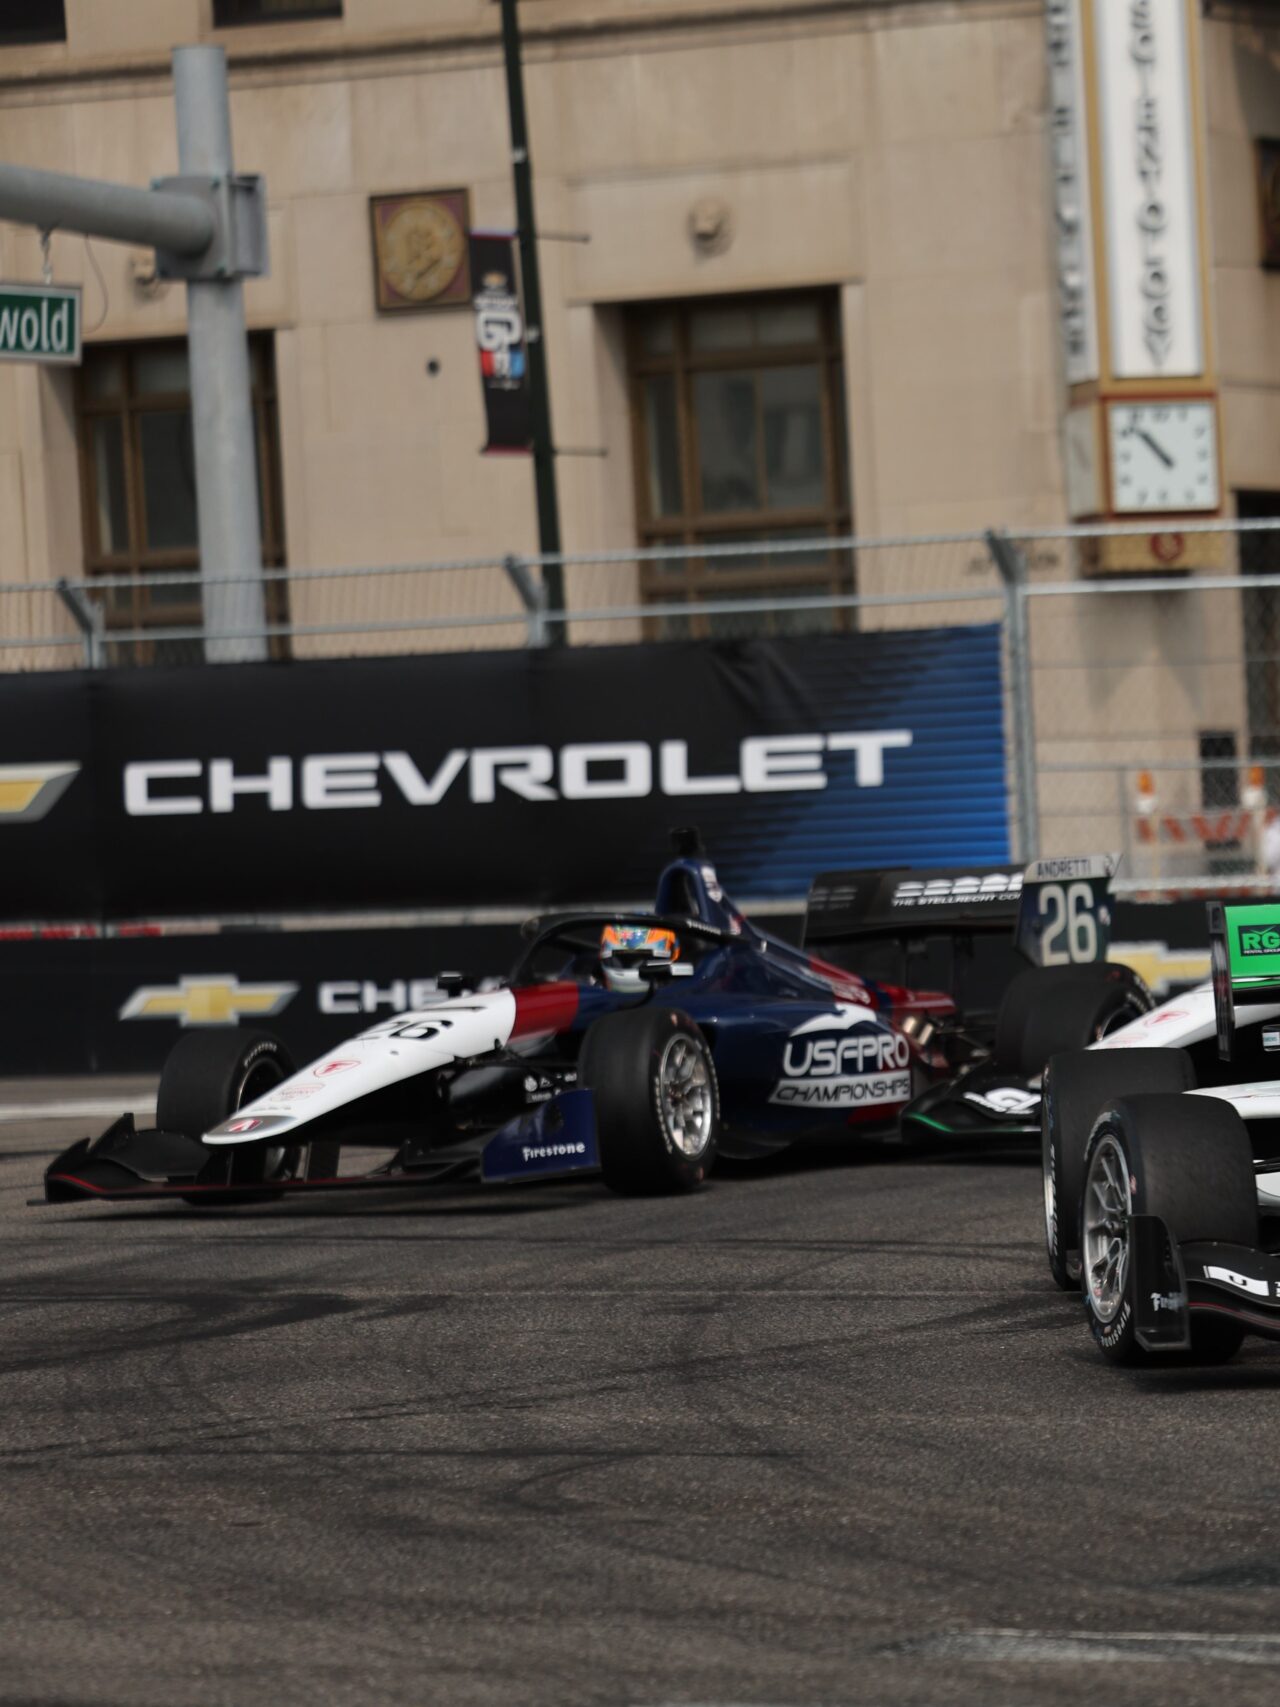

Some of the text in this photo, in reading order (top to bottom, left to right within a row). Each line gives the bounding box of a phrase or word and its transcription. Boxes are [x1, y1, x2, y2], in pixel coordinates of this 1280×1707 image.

[124, 729, 913, 816] CHEVROLET
[1036, 857, 1092, 877] ANDRETTI
[1039, 881, 1097, 967] 26
[776, 1080, 910, 1102] CHAMPIONSHIPS
[522, 1141, 586, 1161] Firestone
